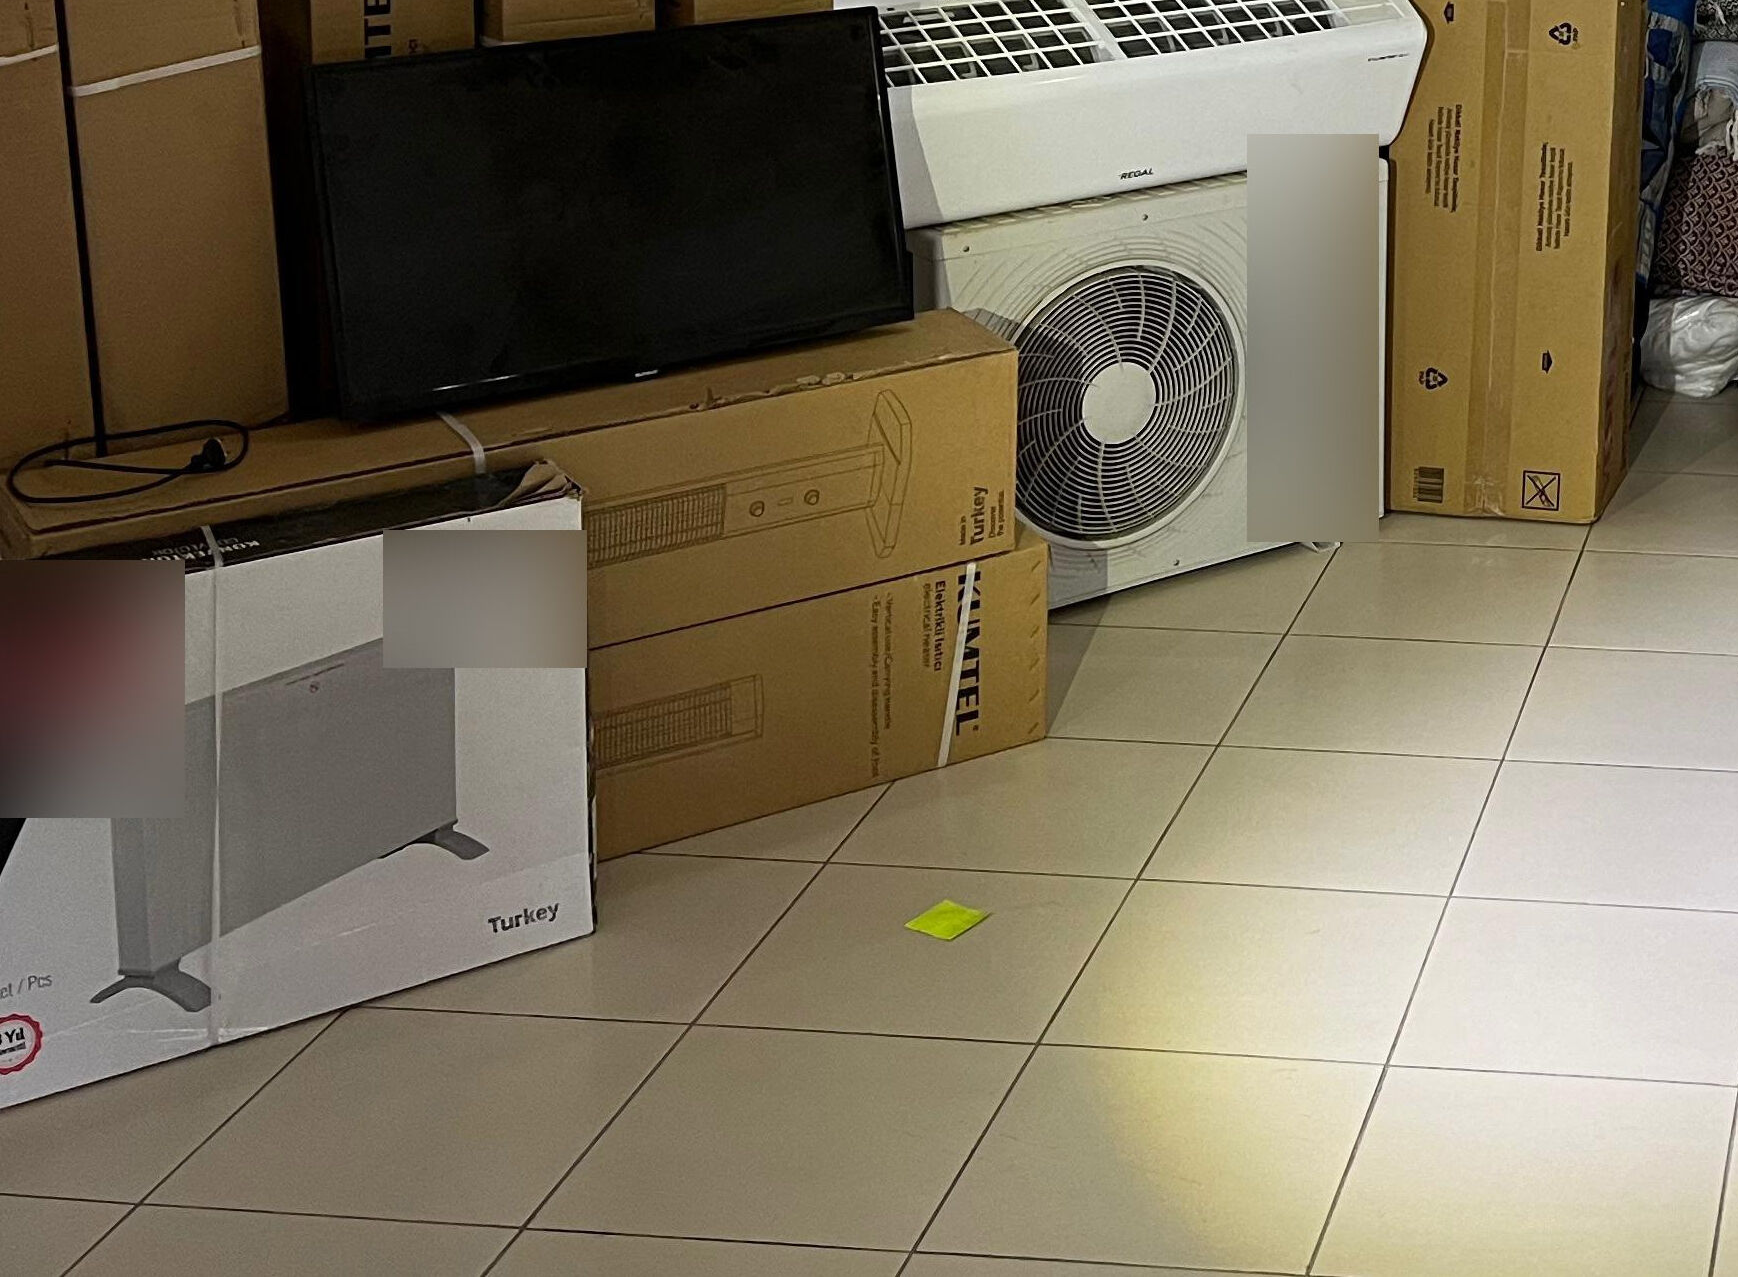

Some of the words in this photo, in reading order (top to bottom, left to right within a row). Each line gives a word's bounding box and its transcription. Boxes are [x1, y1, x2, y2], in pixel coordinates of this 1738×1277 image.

[970, 486, 989, 545] Turkey
[487, 902, 560, 933] Turkey
[27, 974, 53, 991] Pcs
